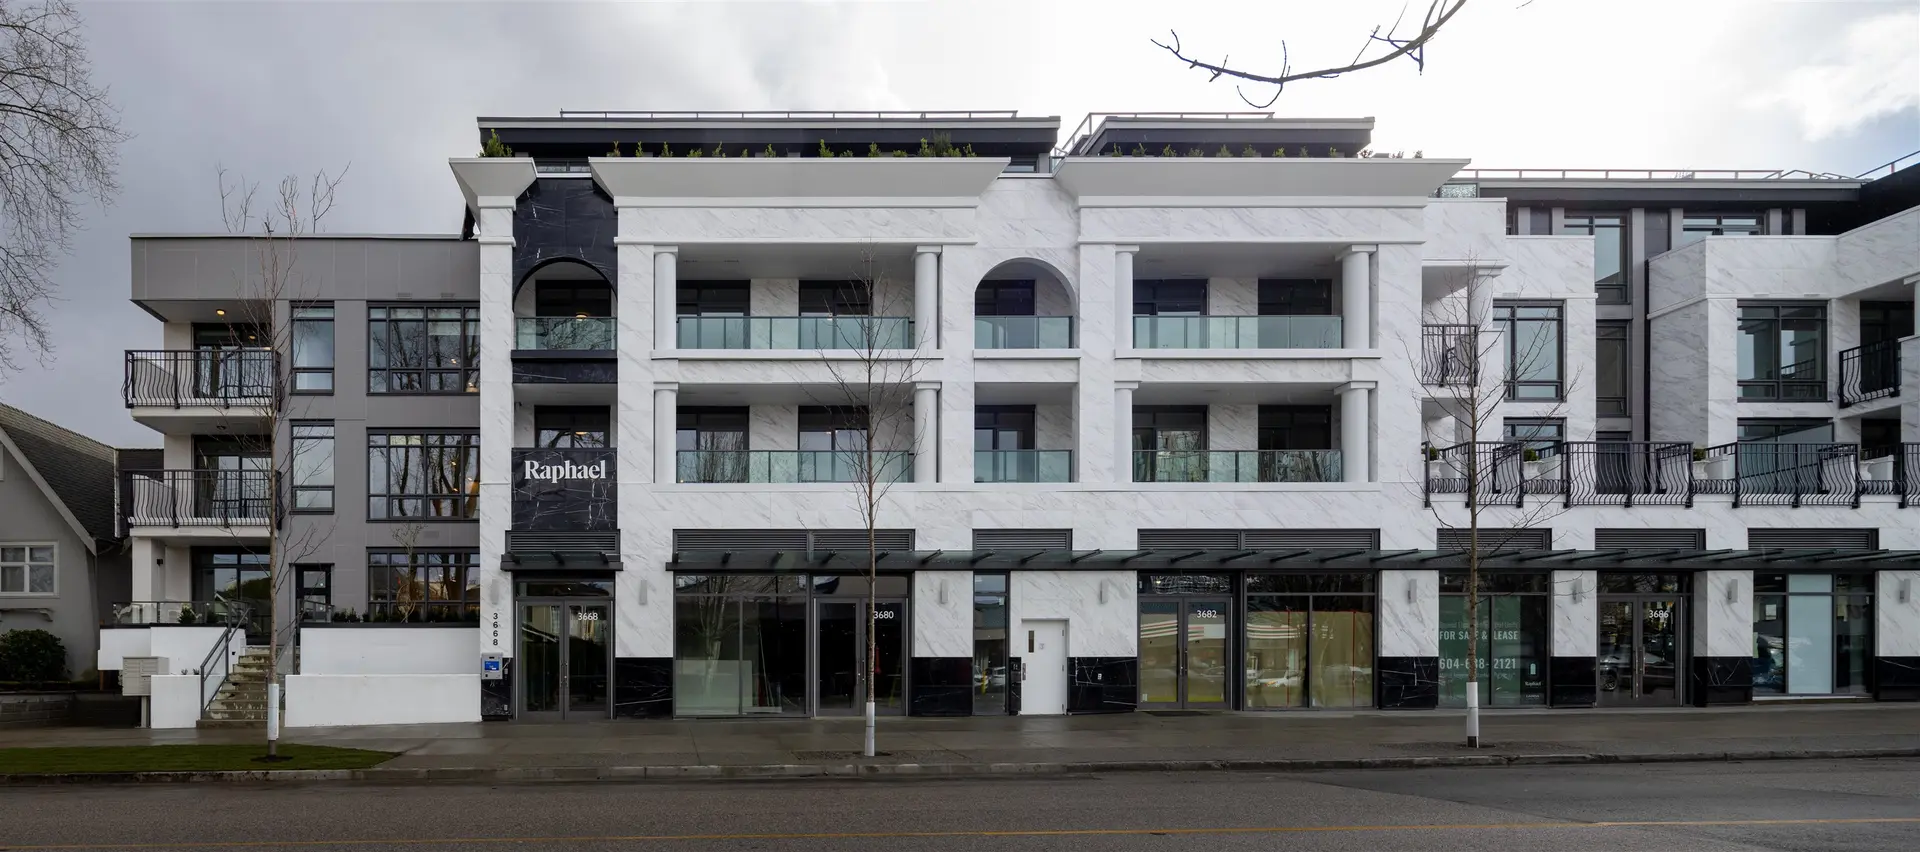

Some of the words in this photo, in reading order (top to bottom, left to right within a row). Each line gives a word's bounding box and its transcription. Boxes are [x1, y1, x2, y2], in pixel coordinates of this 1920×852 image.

[524, 460, 606, 483] Raphael
[577, 612, 598, 621] 3668
[873, 611, 894, 620] 3680
[1196, 610, 1217, 619] 3682
[1649, 610, 1669, 619] 3686
[1439, 631, 1456, 640] FOR
[1458, 631, 1479, 640] SAE
[1481, 631, 1488, 640] &
[1493, 631, 1519, 640] LEASE
